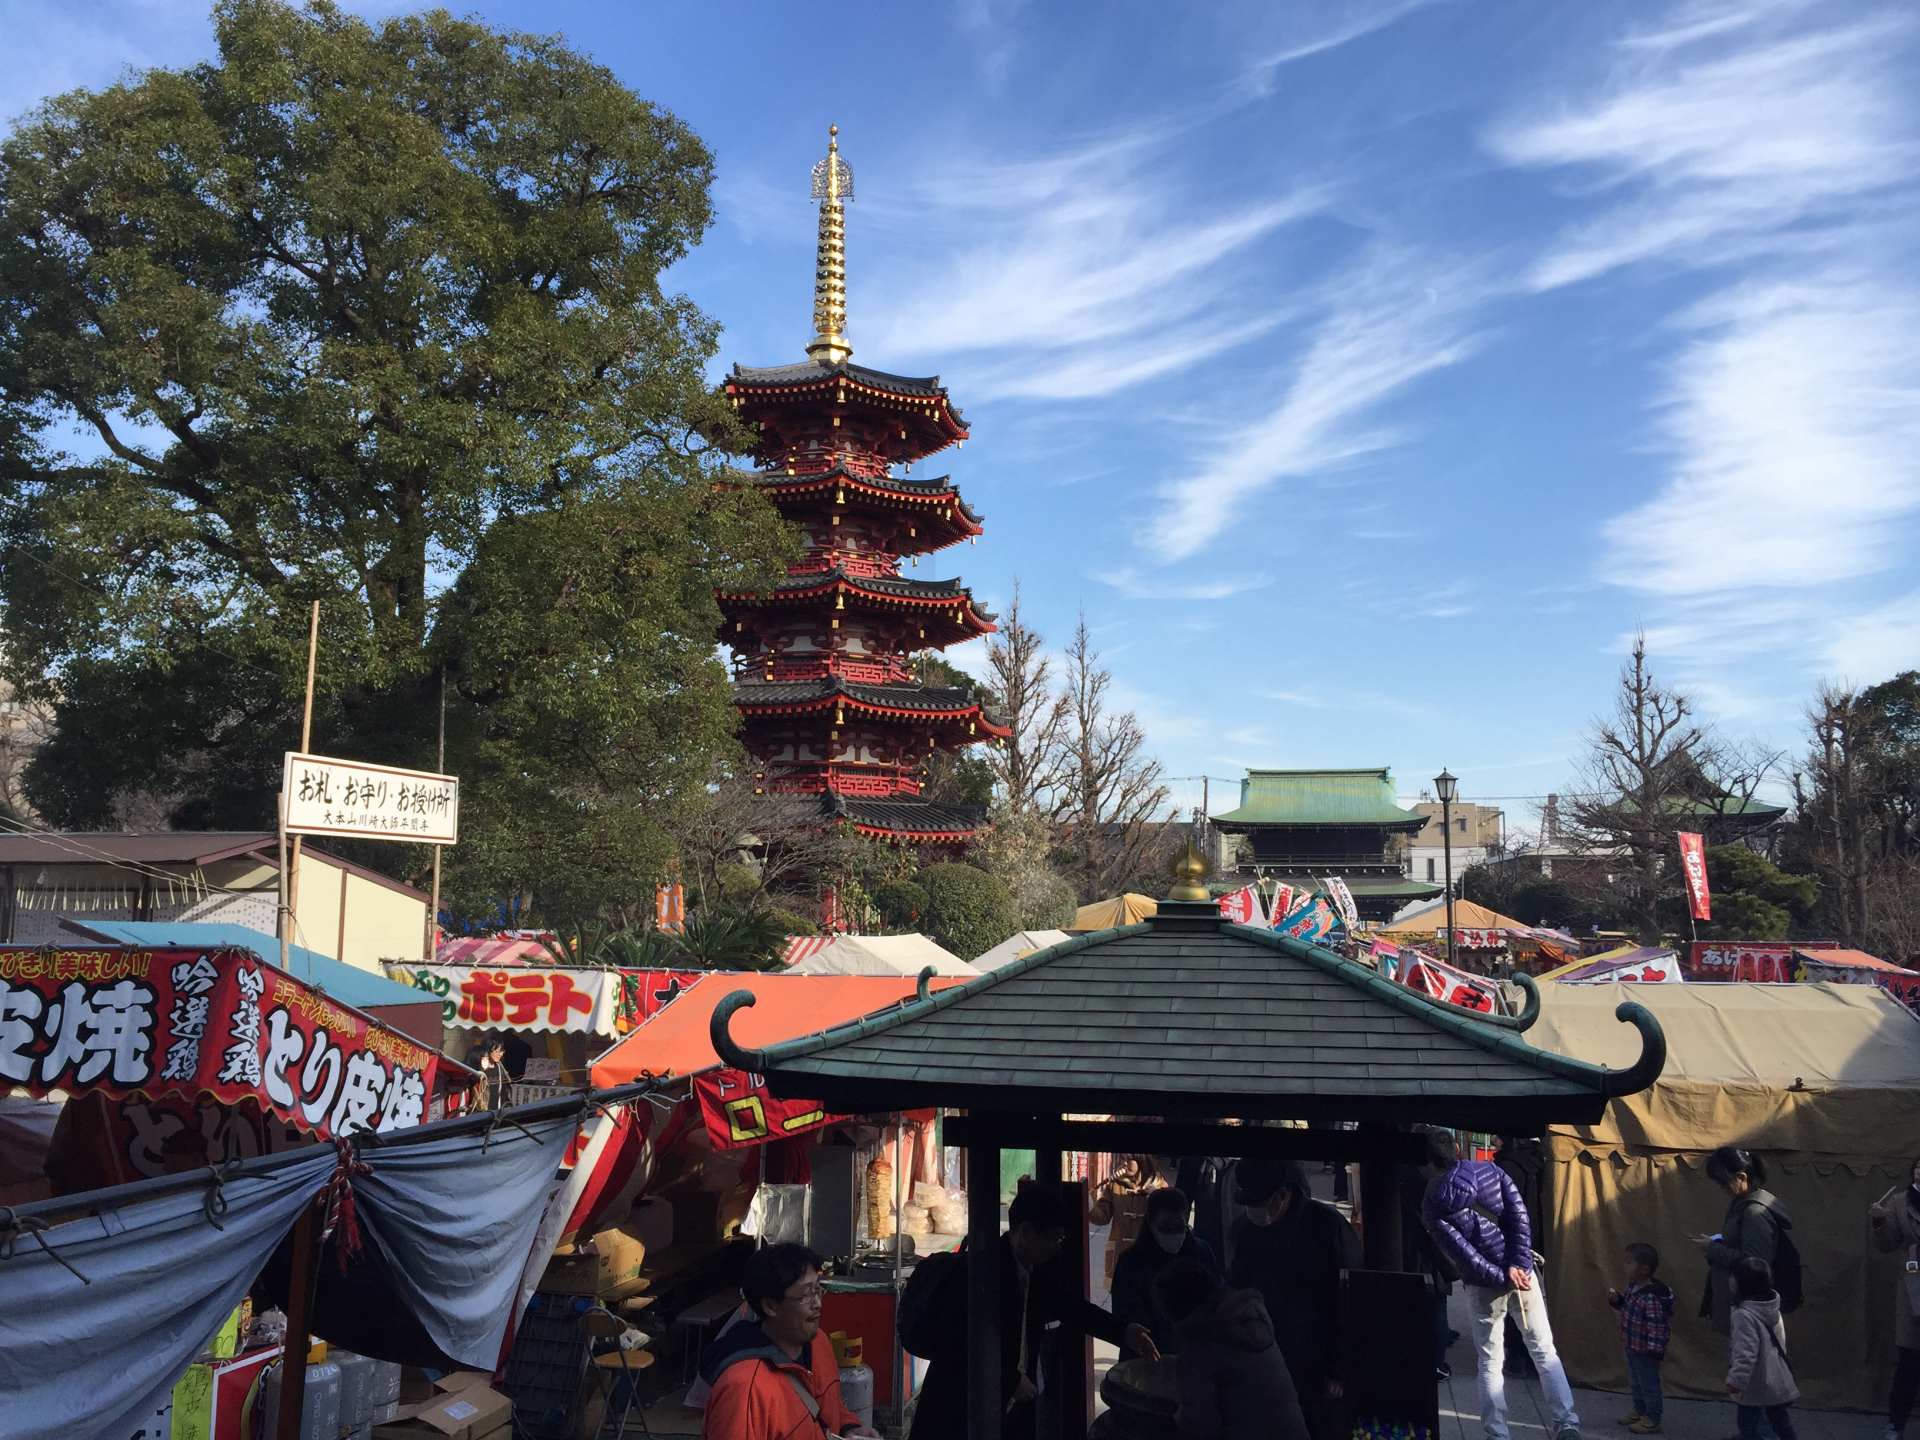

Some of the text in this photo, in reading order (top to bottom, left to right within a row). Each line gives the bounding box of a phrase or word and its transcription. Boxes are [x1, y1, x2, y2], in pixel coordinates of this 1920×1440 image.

[299, 769, 450, 818] お札・お守り・お授け所
[458, 971, 593, 1027] ポテト
[264, 1008, 425, 1137] とり皮焼
